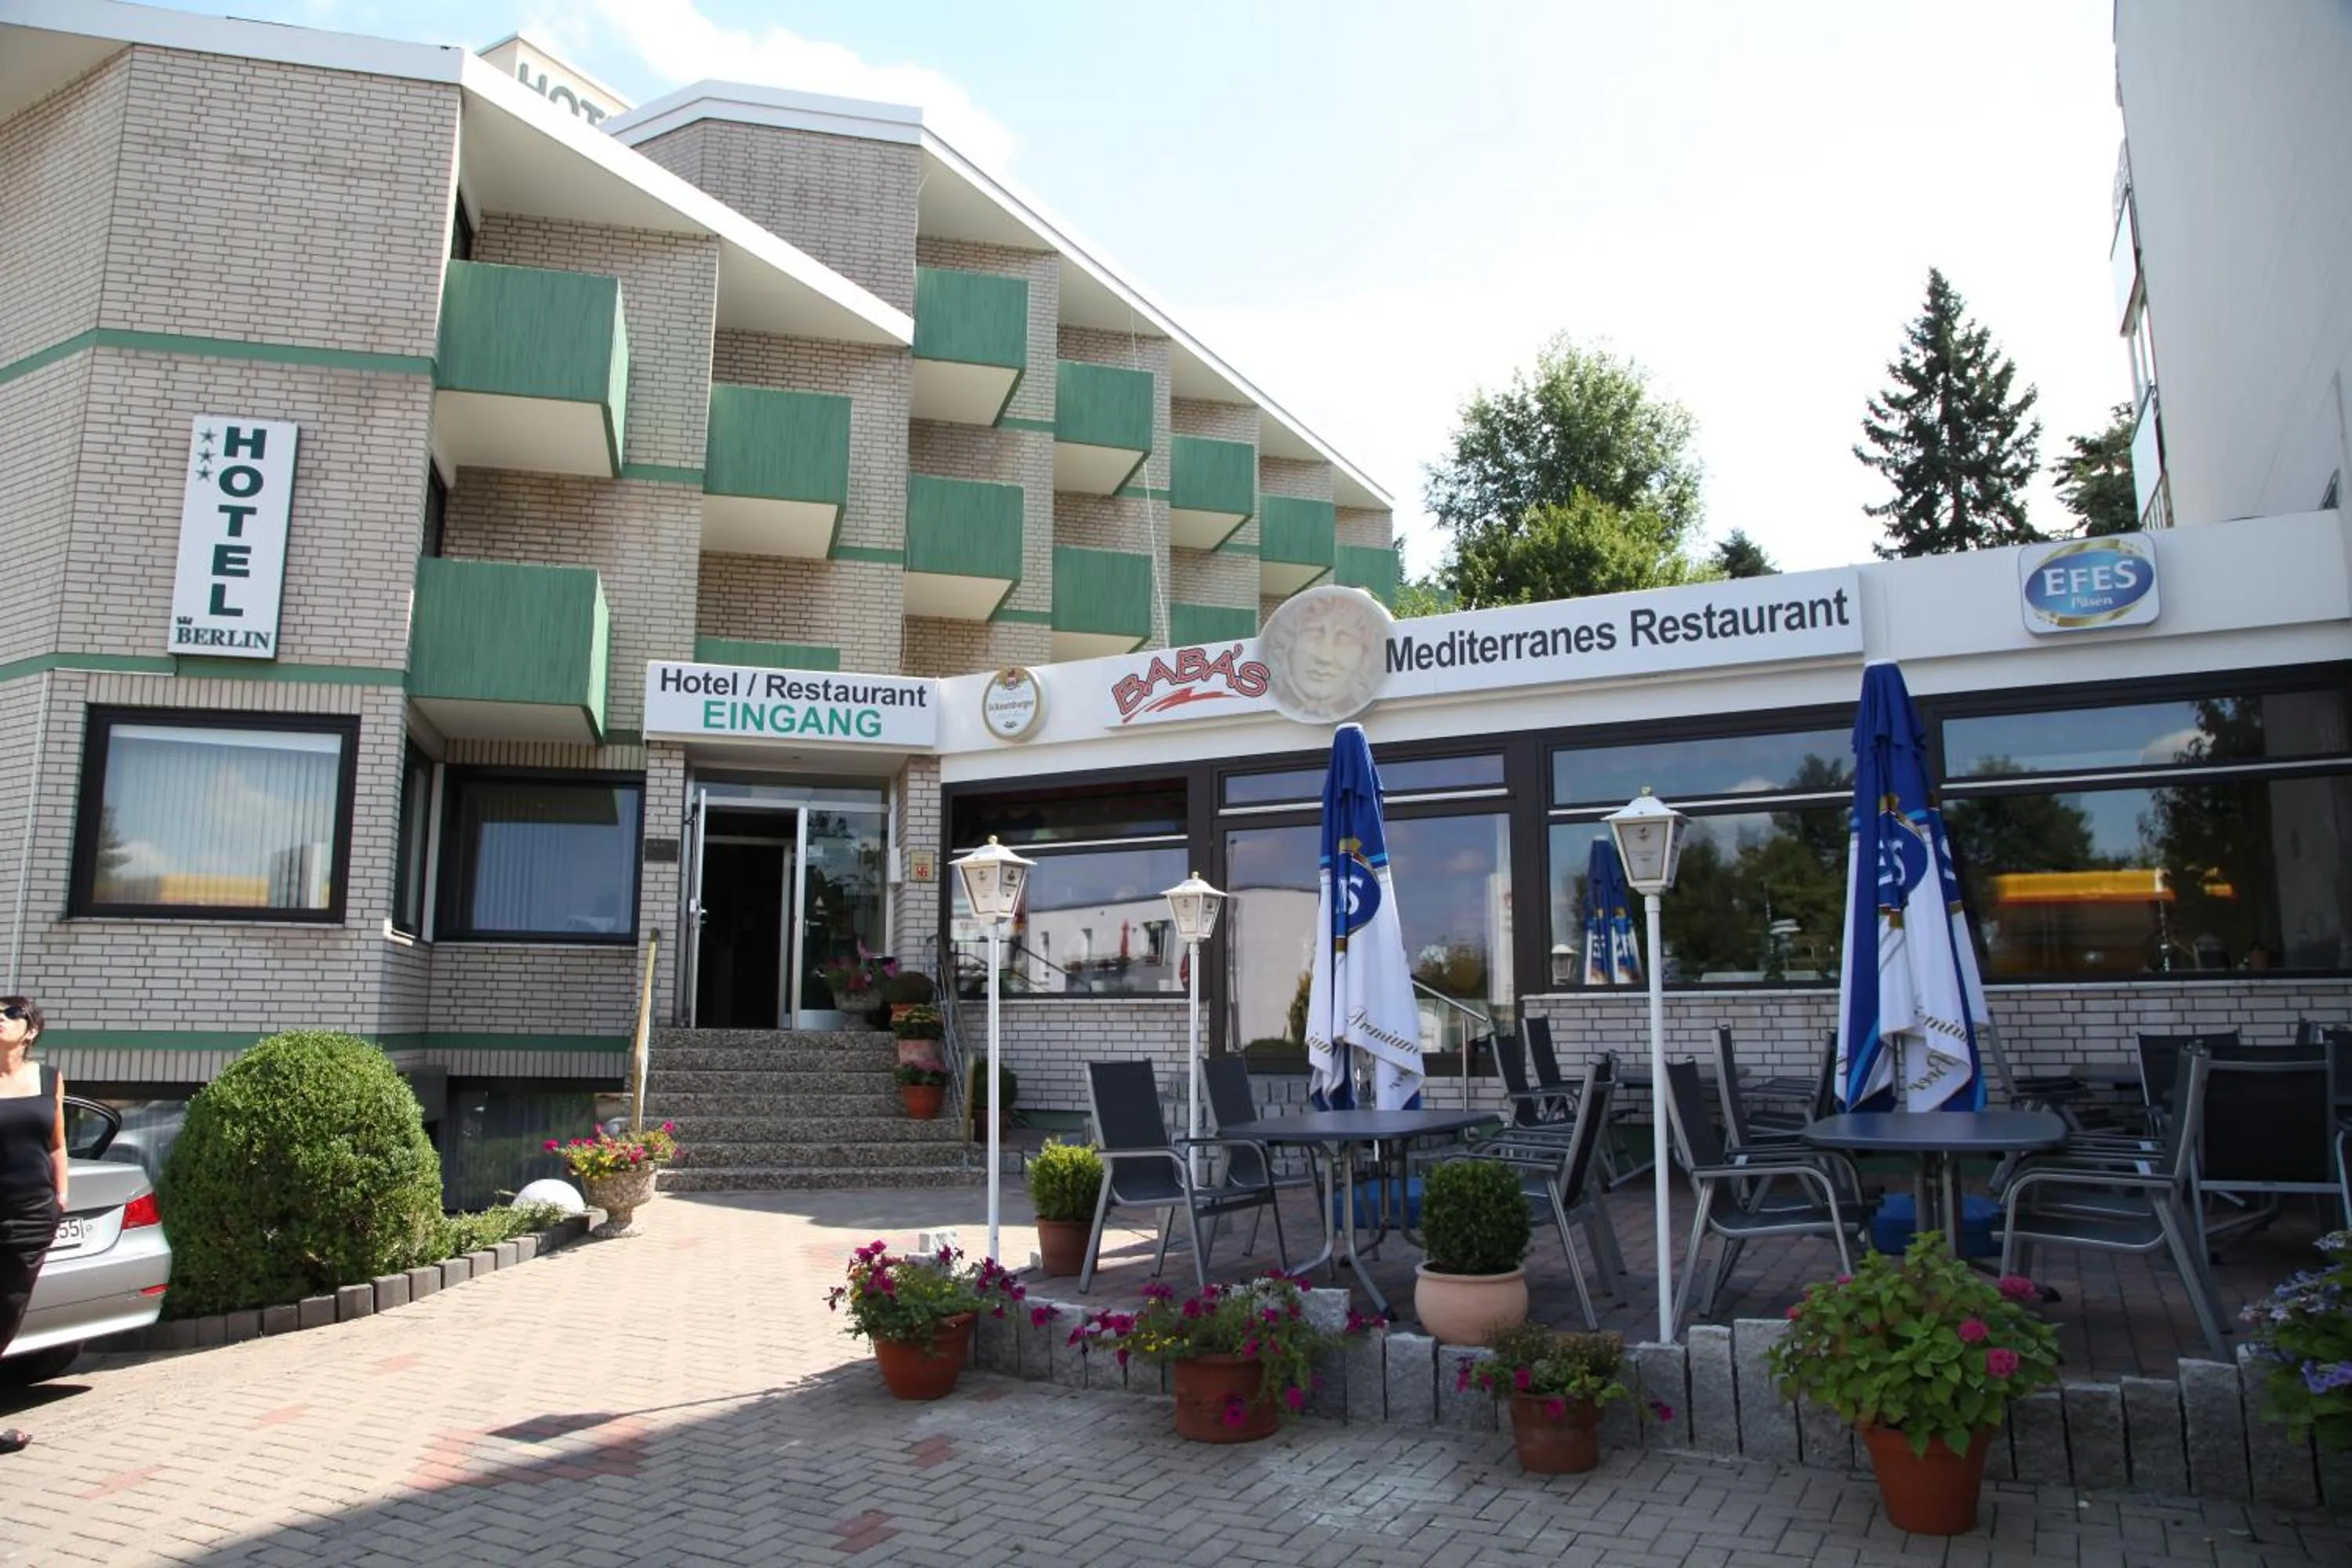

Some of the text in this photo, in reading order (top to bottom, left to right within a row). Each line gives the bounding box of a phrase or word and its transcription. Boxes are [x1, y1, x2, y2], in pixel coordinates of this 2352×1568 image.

[518, 62, 614, 125] HOT
[209, 426, 267, 617] HOTEL
[2043, 559, 2138, 597] EFES
[176, 627, 271, 651] BERLIN
[1385, 587, 1849, 674] Mediterranes Restaurant
[660, 667, 739, 696] Hotel
[765, 673, 927, 708] Restaurant
[702, 700, 883, 738] EINGANG
